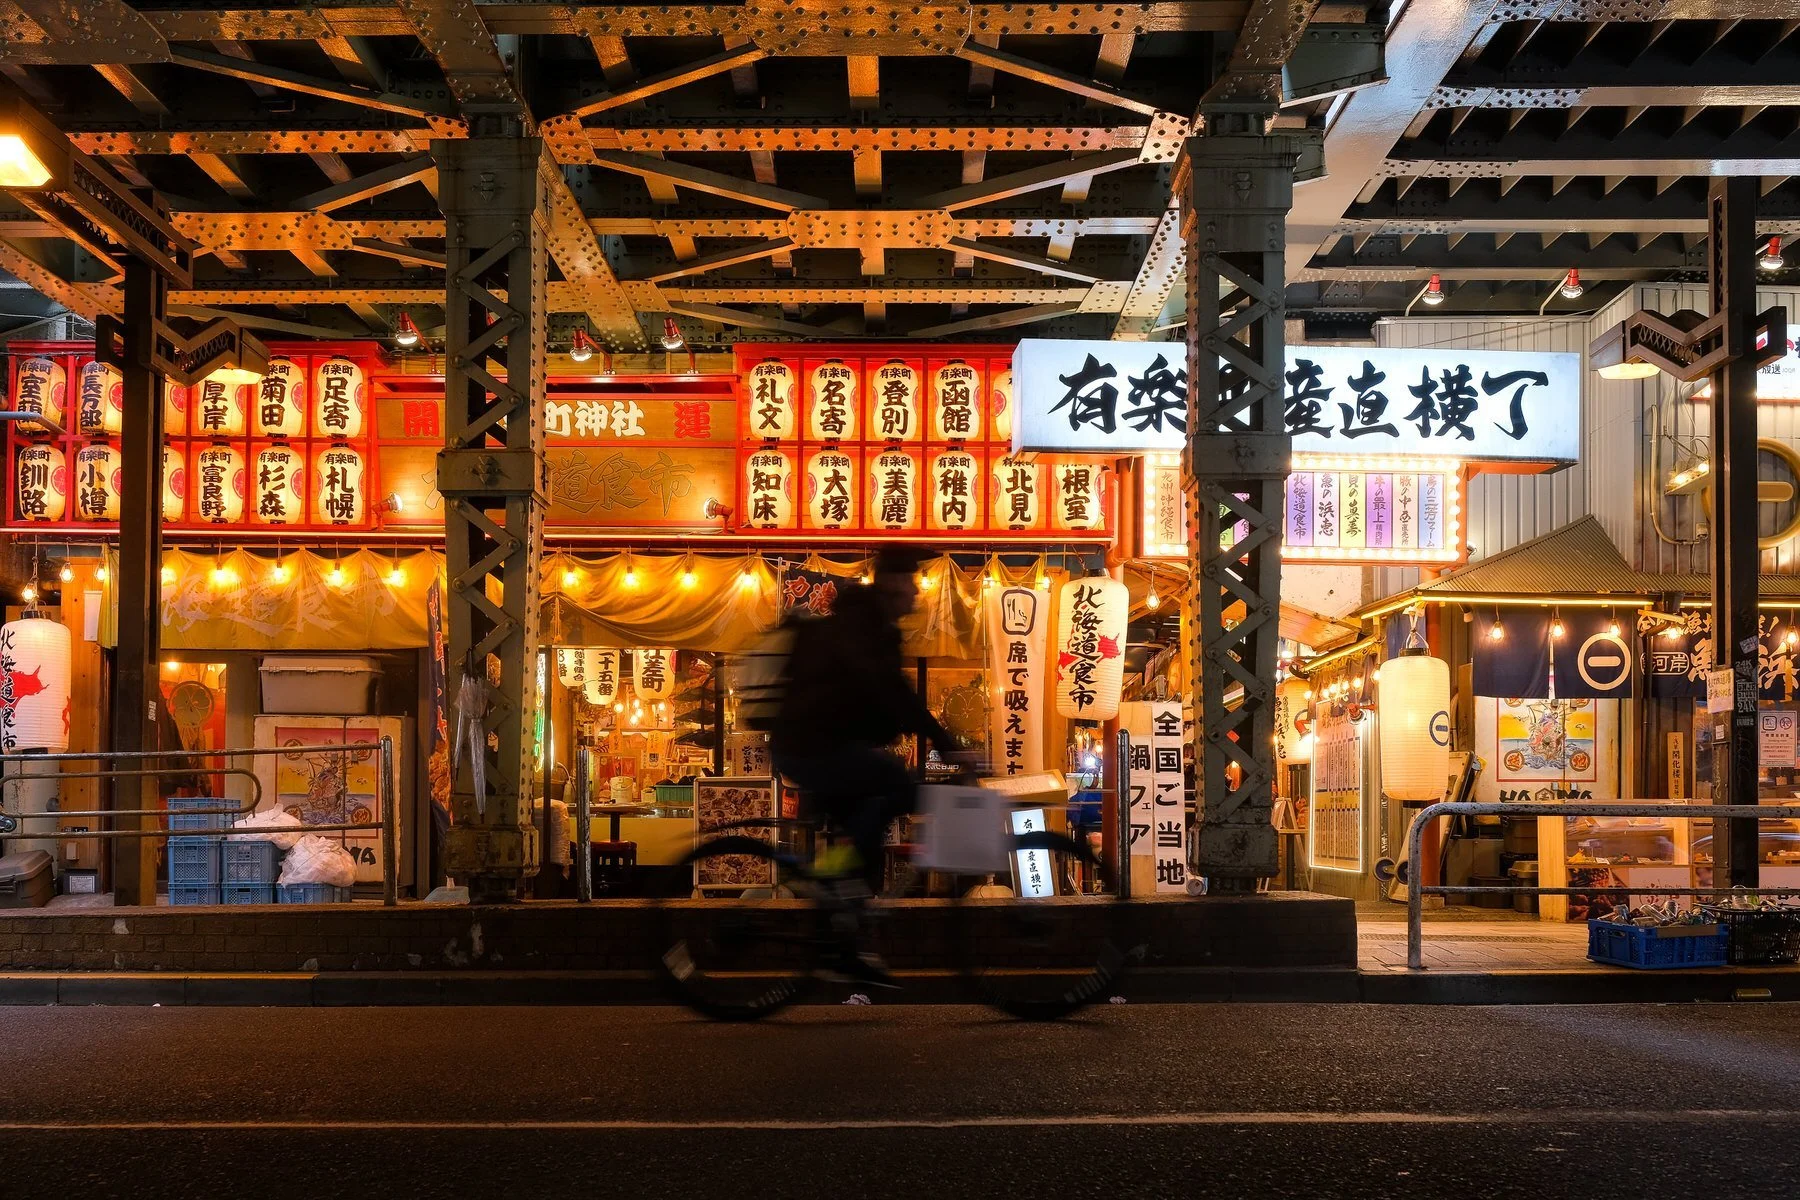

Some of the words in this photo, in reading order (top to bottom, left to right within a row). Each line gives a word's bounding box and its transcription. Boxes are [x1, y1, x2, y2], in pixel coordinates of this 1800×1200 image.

[268, 364, 291, 376] 楽町
[321, 364, 354, 377] 有楽町
[755, 364, 787, 378] 有楽町
[819, 367, 851, 380] 有楽町
[880, 367, 912, 380] 有楽町
[940, 368, 973, 380] 有楽町
[80, 375, 103, 427] 長万部
[202, 380, 228, 430] 厚岸
[261, 376, 288, 427] 菊田
[323, 377, 349, 429] 足寄
[403, 401, 440, 437] 開
[673, 401, 711, 438] 運
[756, 378, 784, 430] 礼文
[820, 380, 847, 435] 名寄
[881, 380, 910, 436] 登別
[941, 380, 972, 433] 函館
[20, 450, 52, 463] 有楽町
[79, 450, 110, 463] 有楽町
[200, 451, 232, 464] 有楽町
[259, 452, 291, 465] 有楽町
[325, 453, 358, 466] 有楽町
[751, 455, 783, 468] 有楽町
[819, 455, 850, 468] 有楽町
[879, 455, 911, 468] 有楽町
[938, 456, 971, 469] 有楽町
[20, 463, 49, 516] 釧路
[80, 463, 110, 516] 小樽
[201, 464, 227, 517] 富良野
[259, 464, 286, 517] 杉森
[325, 466, 354, 519] 札幌
[752, 468, 782, 521] 知床
[820, 468, 850, 522] 大塚
[939, 469, 968, 523] 稚内
[1005, 469, 1034, 522] 北見
[1062, 469, 1091, 521] 根室
[1068, 583, 1105, 713] 北海道食市
[1642, 653, 1689, 673] 河岸
[1154, 710, 1185, 886] 全国ご当地
[1023, 818, 1042, 895] 有産直横丁
